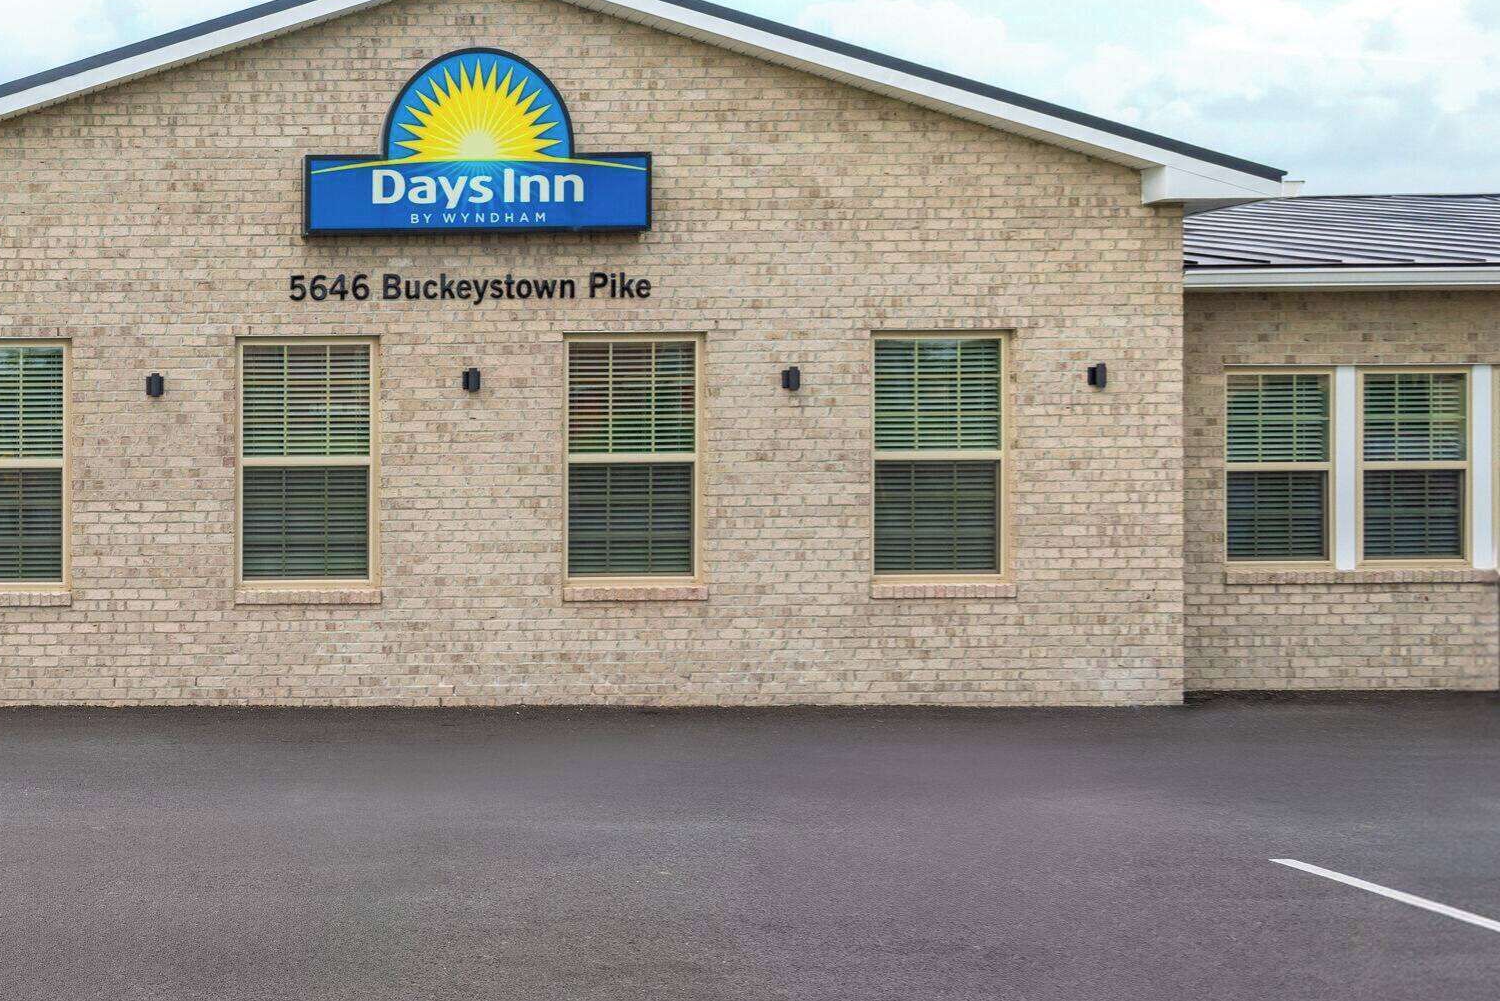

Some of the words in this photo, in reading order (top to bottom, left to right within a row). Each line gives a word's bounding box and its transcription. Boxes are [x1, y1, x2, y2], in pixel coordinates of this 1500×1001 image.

[371, 168, 495, 210] Days
[503, 168, 585, 203] Inn
[409, 213, 432, 225] BY
[442, 212, 547, 224] WYNDHAM
[289, 273, 370, 301] 5646
[382, 273, 576, 305] Buckeystown
[588, 272, 652, 299] Pike
